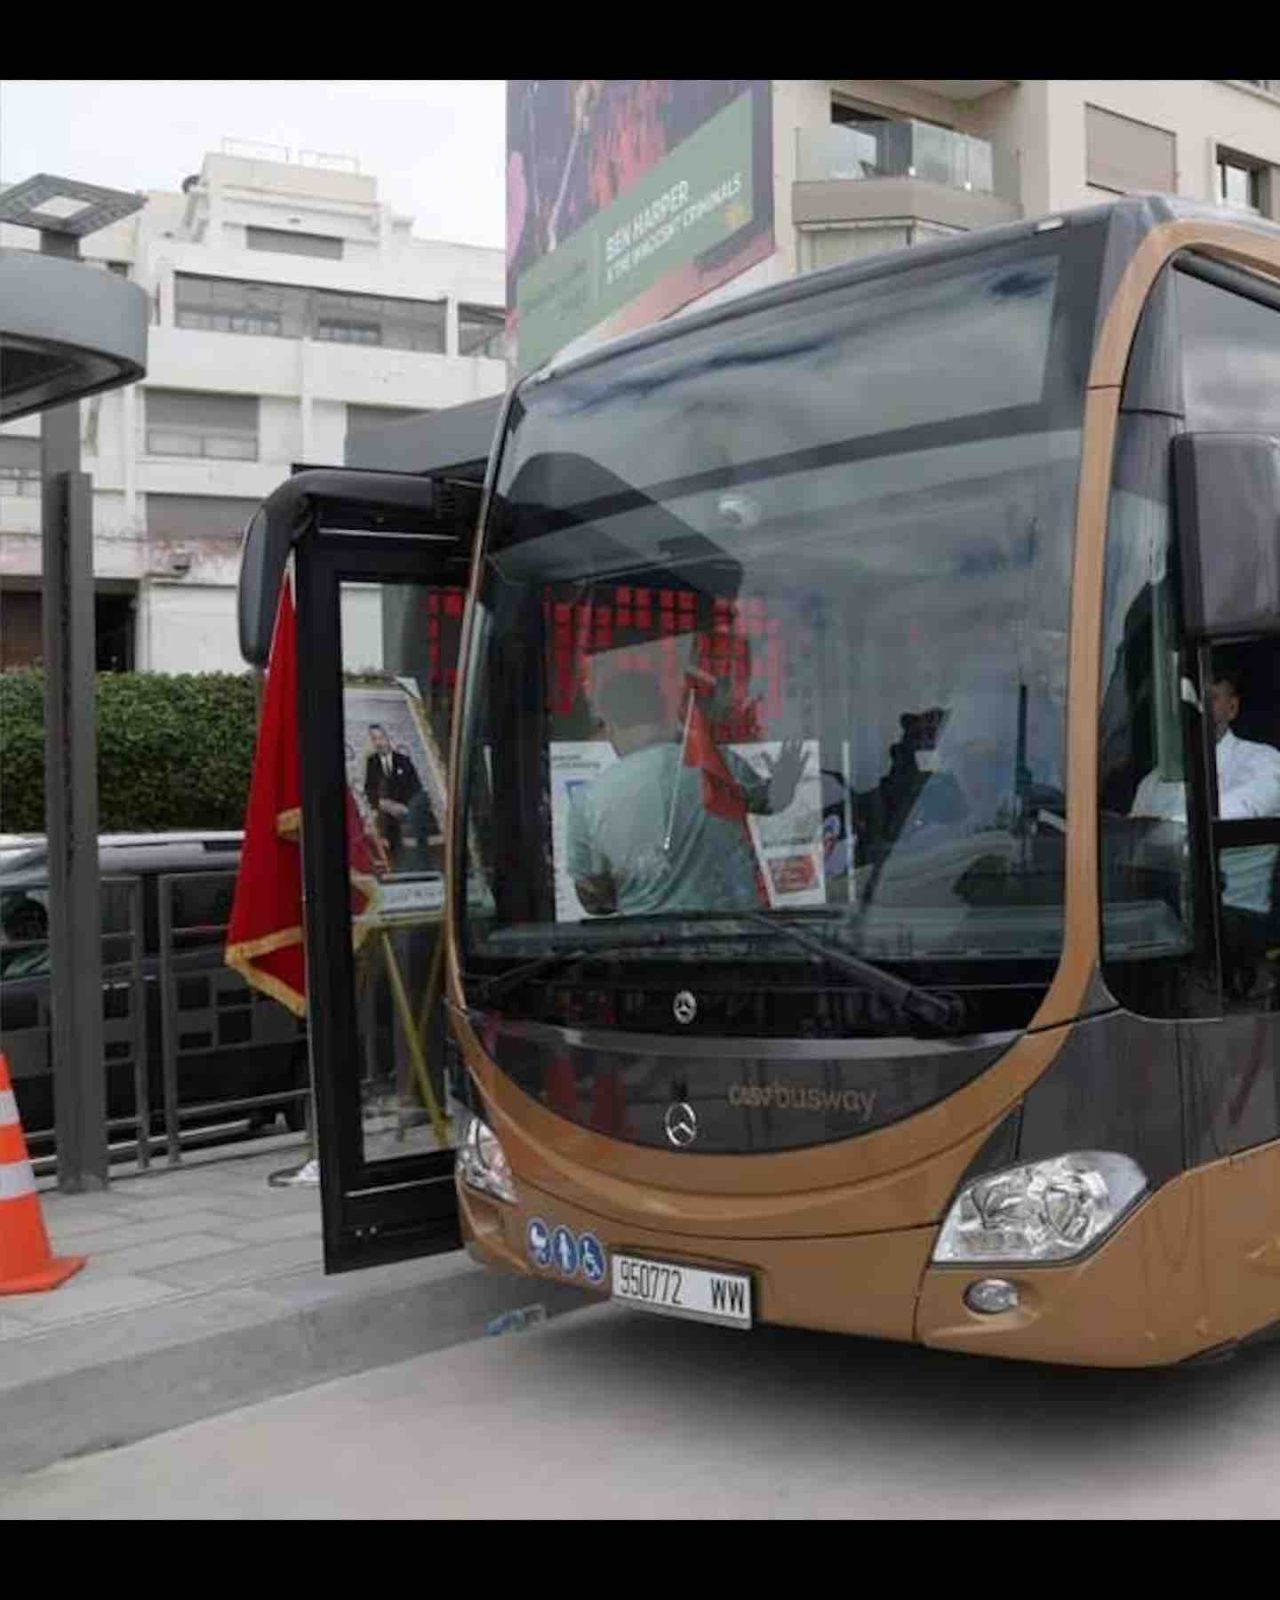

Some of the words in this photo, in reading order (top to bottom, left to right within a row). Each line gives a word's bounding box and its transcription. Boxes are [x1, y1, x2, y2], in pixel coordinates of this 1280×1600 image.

[605, 225, 632, 262] BEN
[632, 180, 689, 242] HARPER
[620, 1260, 683, 1305] 950772
[710, 1277, 746, 1314] WW
